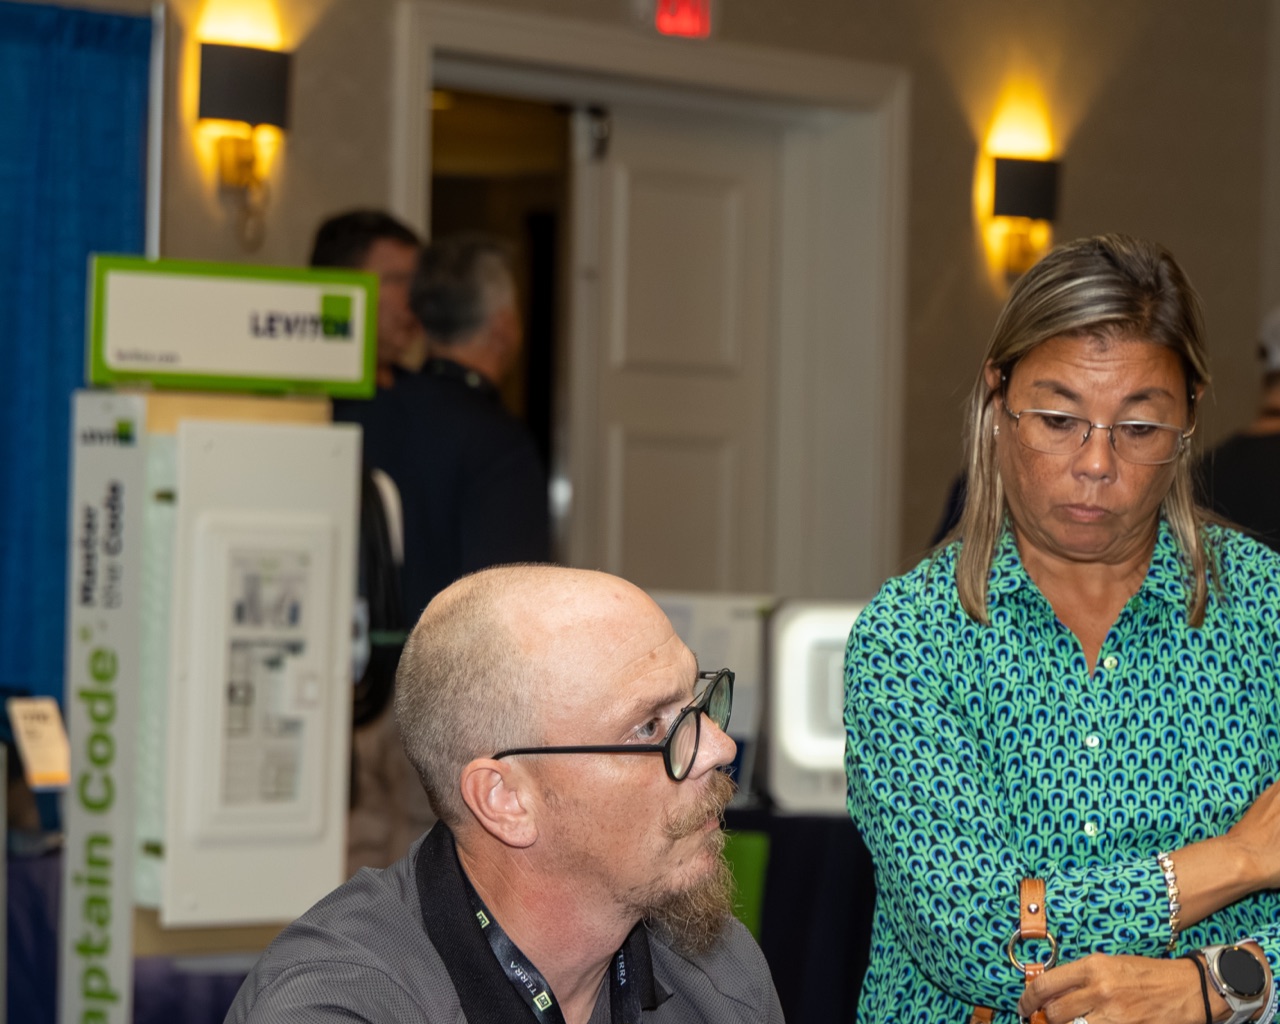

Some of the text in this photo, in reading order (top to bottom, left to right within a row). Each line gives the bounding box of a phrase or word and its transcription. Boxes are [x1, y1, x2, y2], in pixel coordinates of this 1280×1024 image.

[104, 478, 125, 556] Code
[78, 646, 118, 814] Code
[510, 961, 537, 996] TERRA
